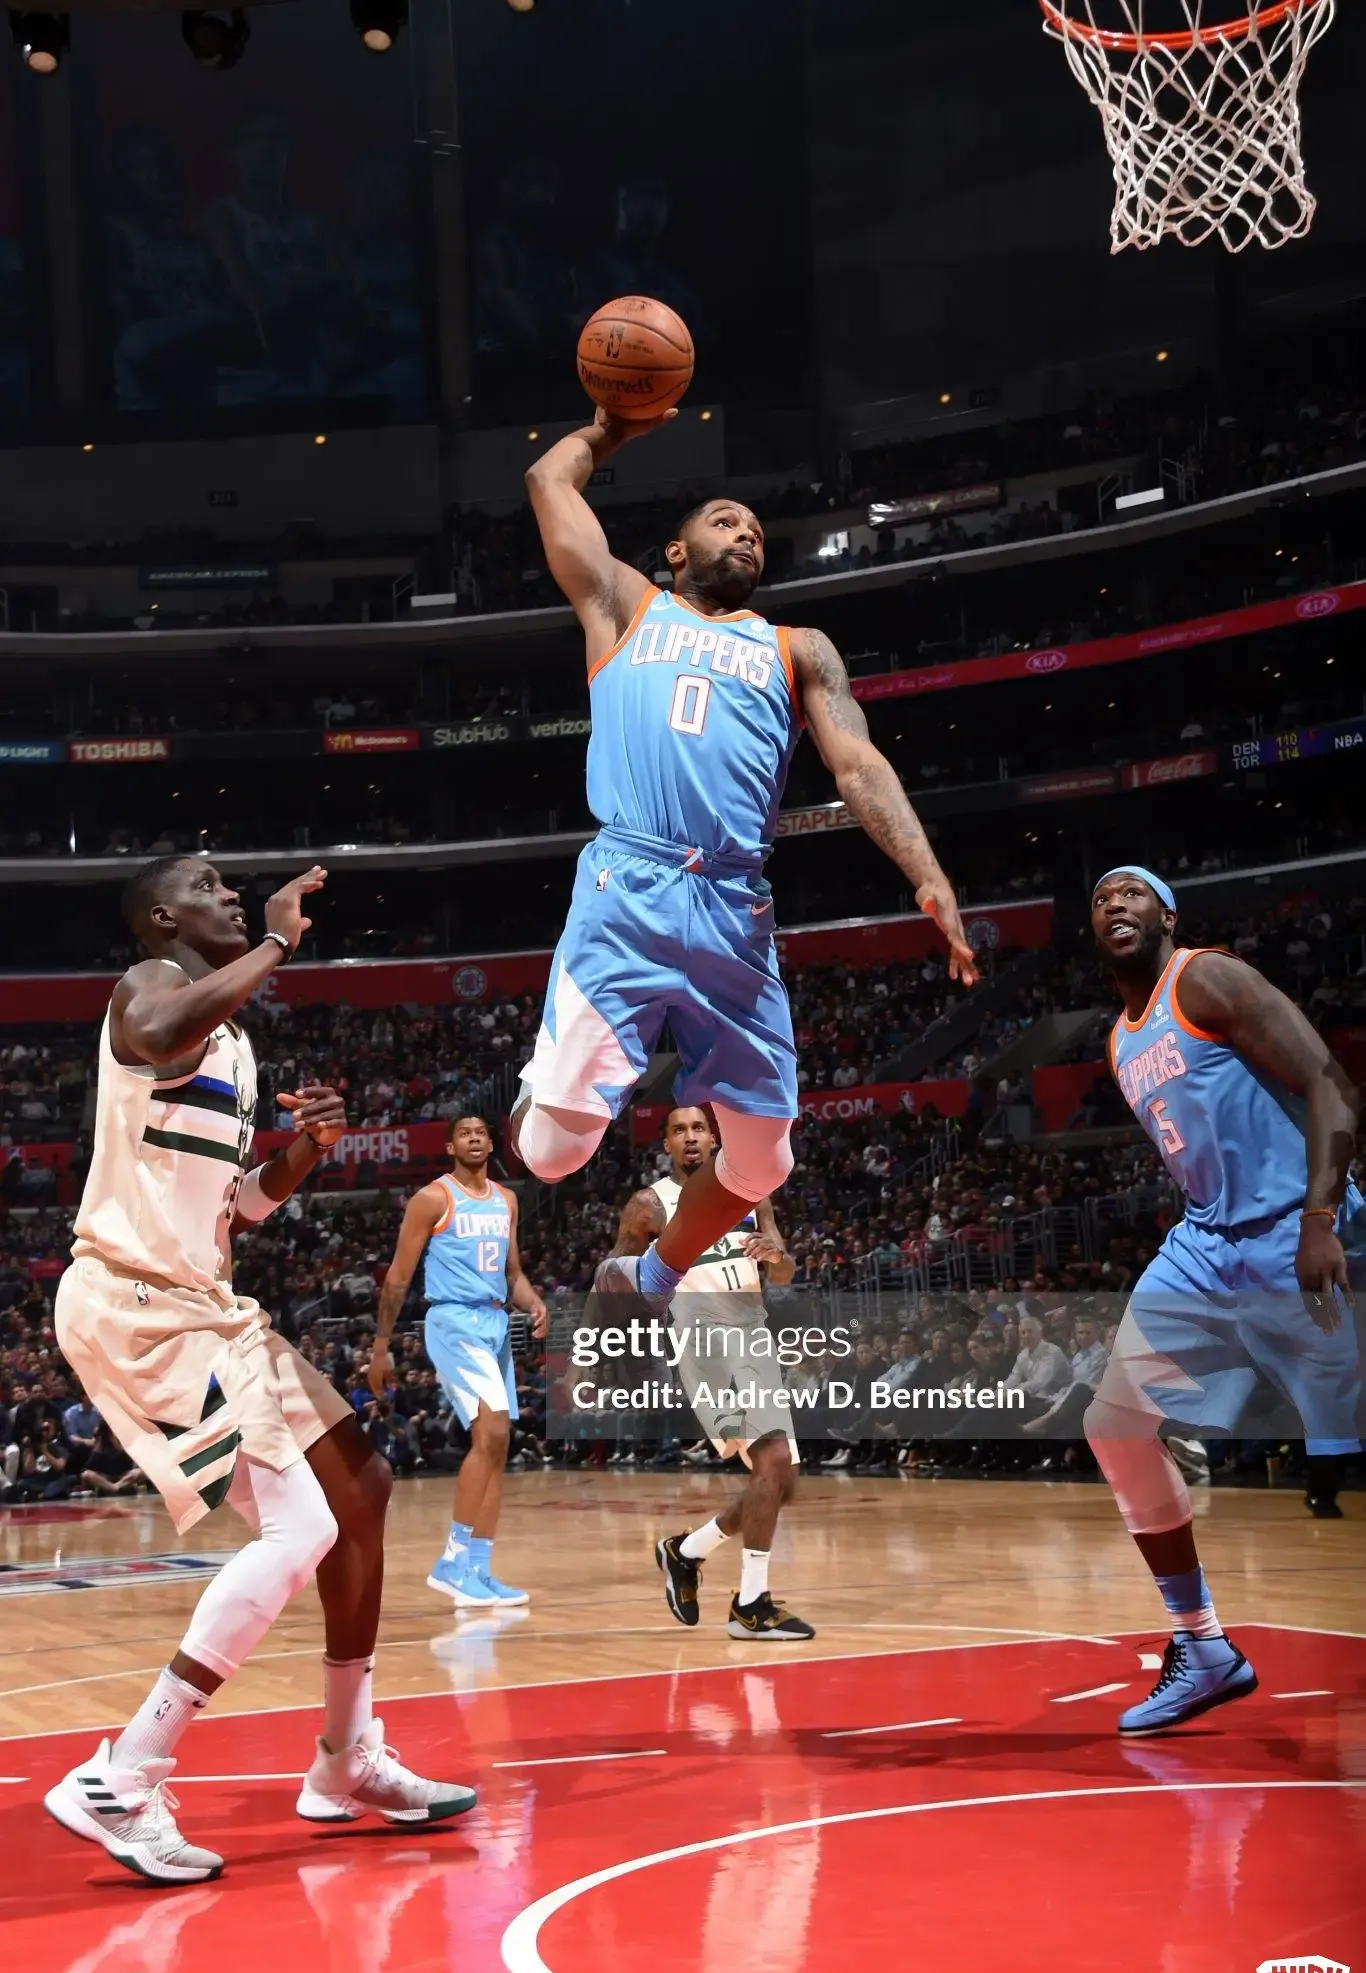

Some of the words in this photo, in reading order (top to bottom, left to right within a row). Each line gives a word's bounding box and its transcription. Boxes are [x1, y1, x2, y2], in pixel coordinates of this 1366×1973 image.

[630, 623, 776, 690] CLIPPERS
[669, 673, 712, 737] 0
[433, 726, 509, 747] StubHub
[1232, 740, 1261, 757] DEN
[1275, 732, 1299, 748] 110
[1334, 732, 1364, 750] NBA
[10, 746, 50, 758] LIGHT
[71, 740, 168, 760] TOSHIBA
[1232, 754, 1260, 770] TOR
[1278, 747, 1300, 761] 114
[1148, 1098, 1187, 1156] 5
[322, 1128, 410, 1168] IPPERS
[455, 1213, 511, 1239] CLIPPERS
[477, 1241, 500, 1272] 12
[721, 1264, 742, 1291] 11
